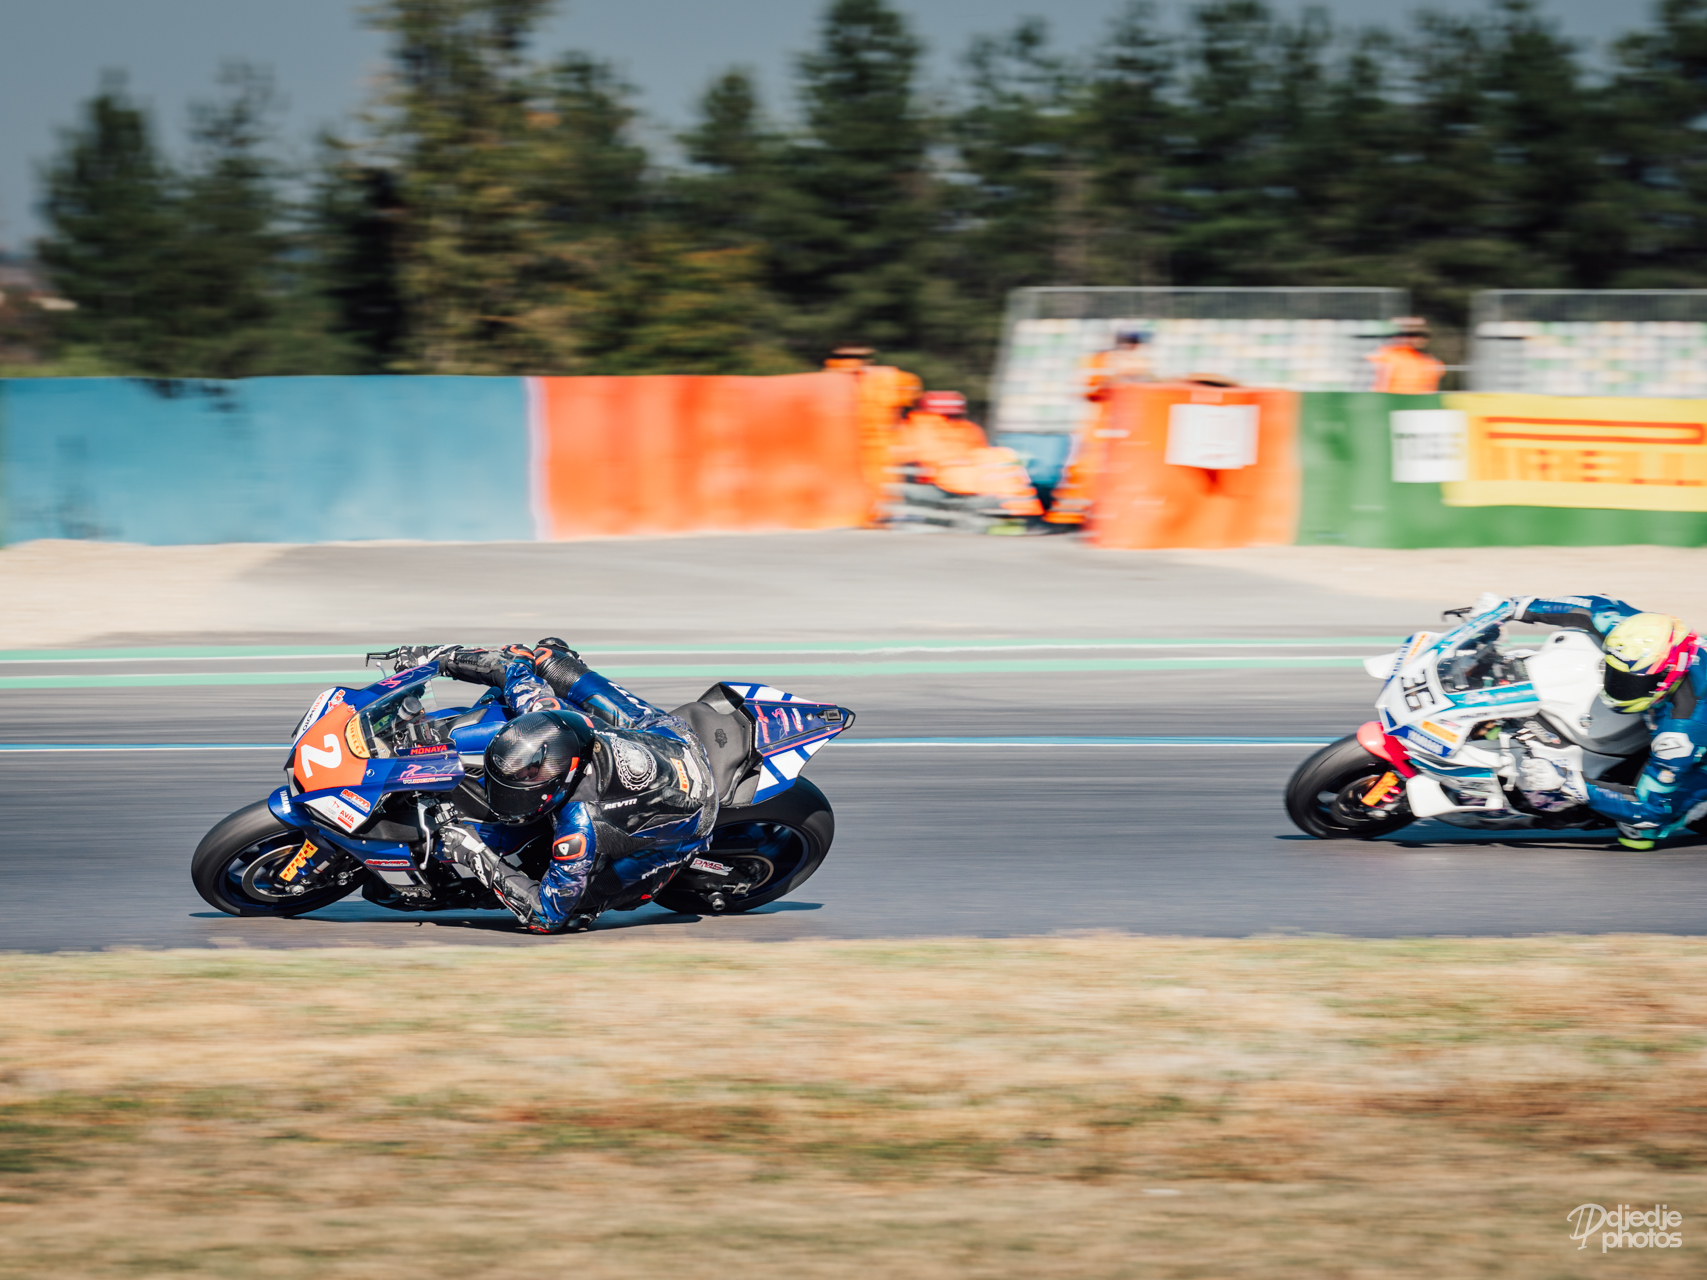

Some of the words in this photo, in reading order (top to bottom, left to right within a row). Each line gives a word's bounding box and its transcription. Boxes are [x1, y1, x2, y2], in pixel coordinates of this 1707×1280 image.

[1471, 415, 1707, 486] PIRELL
[301, 733, 342, 778] 2
[350, 717, 366, 755] PIRELLI
[410, 744, 448, 755] MONAYA
